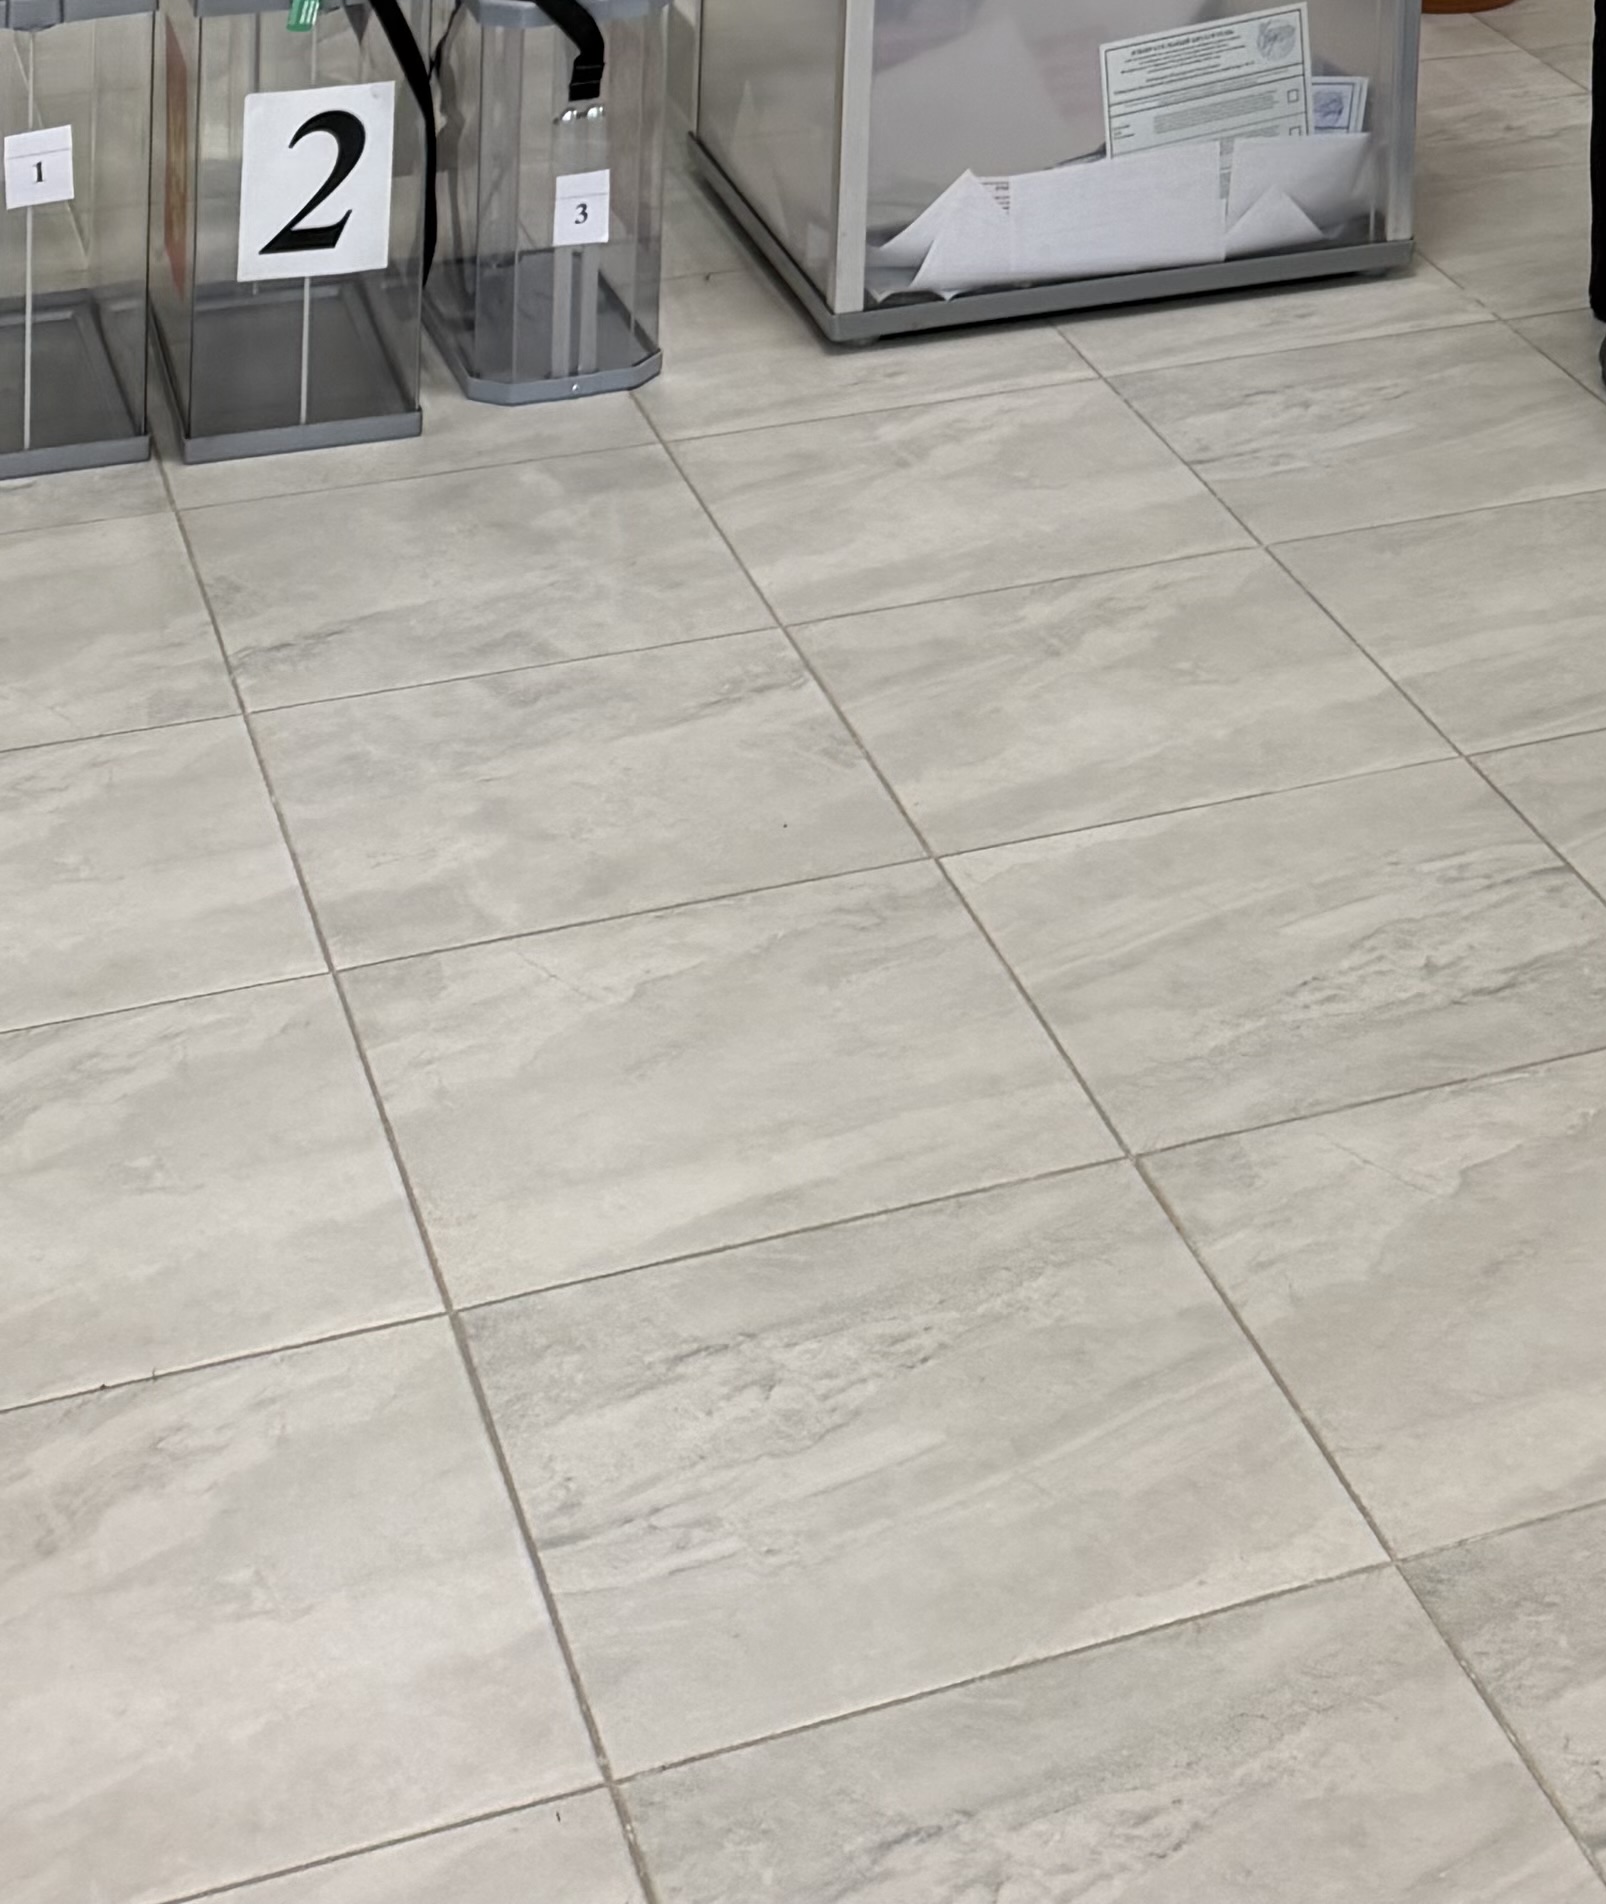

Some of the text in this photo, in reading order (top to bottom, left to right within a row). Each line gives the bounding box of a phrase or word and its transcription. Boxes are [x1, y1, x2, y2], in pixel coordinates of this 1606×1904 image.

[31, 160, 44, 184] 1
[258, 109, 366, 256] 2
[574, 202, 588, 225] 3
